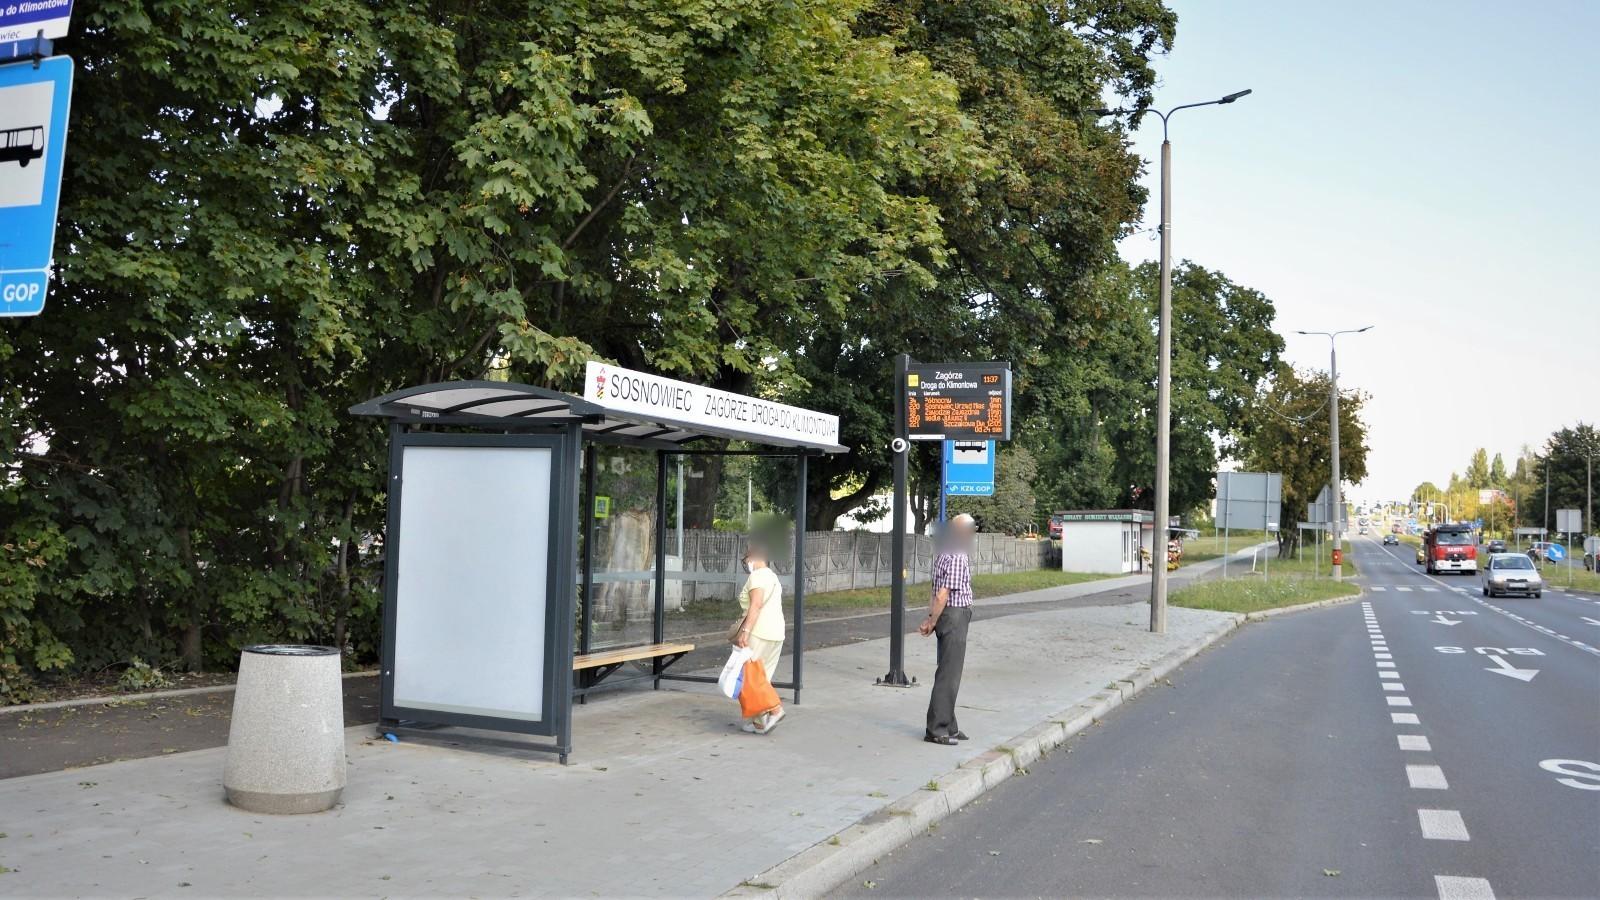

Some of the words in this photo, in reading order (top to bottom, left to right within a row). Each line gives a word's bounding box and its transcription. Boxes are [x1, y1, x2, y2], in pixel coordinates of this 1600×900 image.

[6, 4, 18, 16] do
[18, 0, 69, 14] Klimontowa
[3, 283, 39, 303] GOP
[935, 371, 963, 381] Zagórze
[920, 381, 938, 391] Droga
[938, 381, 946, 389] do
[946, 381, 978, 389] Klimontowa
[610, 373, 693, 412] SOSNOWIEC
[704, 392, 748, 422] ZAGÓRZE
[751, 404, 779, 426] DROGA
[779, 409, 791, 430] DO
[792, 412, 837, 436] KLIMONTOWA
[1433, 646, 1547, 656] BUS
